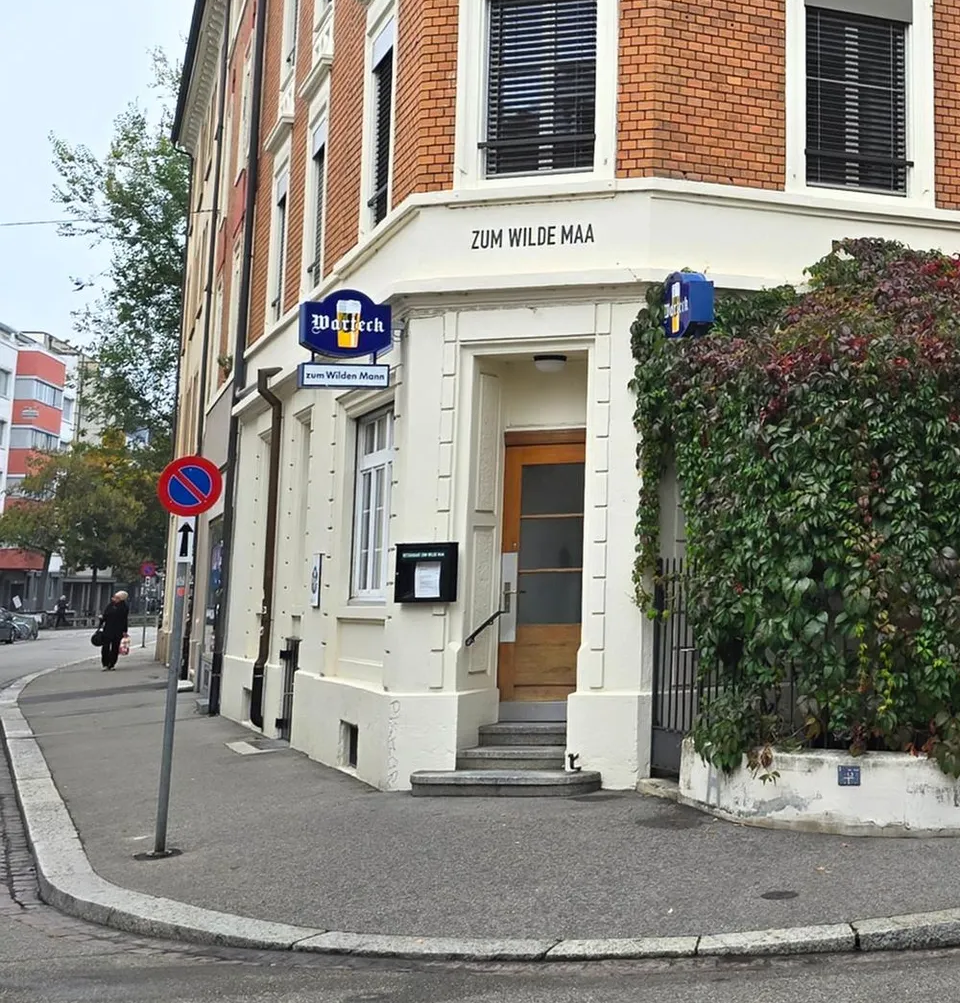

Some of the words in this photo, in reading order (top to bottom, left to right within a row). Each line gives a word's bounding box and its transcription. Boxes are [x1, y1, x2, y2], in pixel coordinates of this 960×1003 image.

[471, 229, 503, 249] ZUM
[508, 226, 556, 247] WILDE
[561, 223, 595, 245] MAA
[311, 314, 385, 334] Warteck
[326, 371, 357, 380] Wilden
[359, 372, 385, 380] Mann
